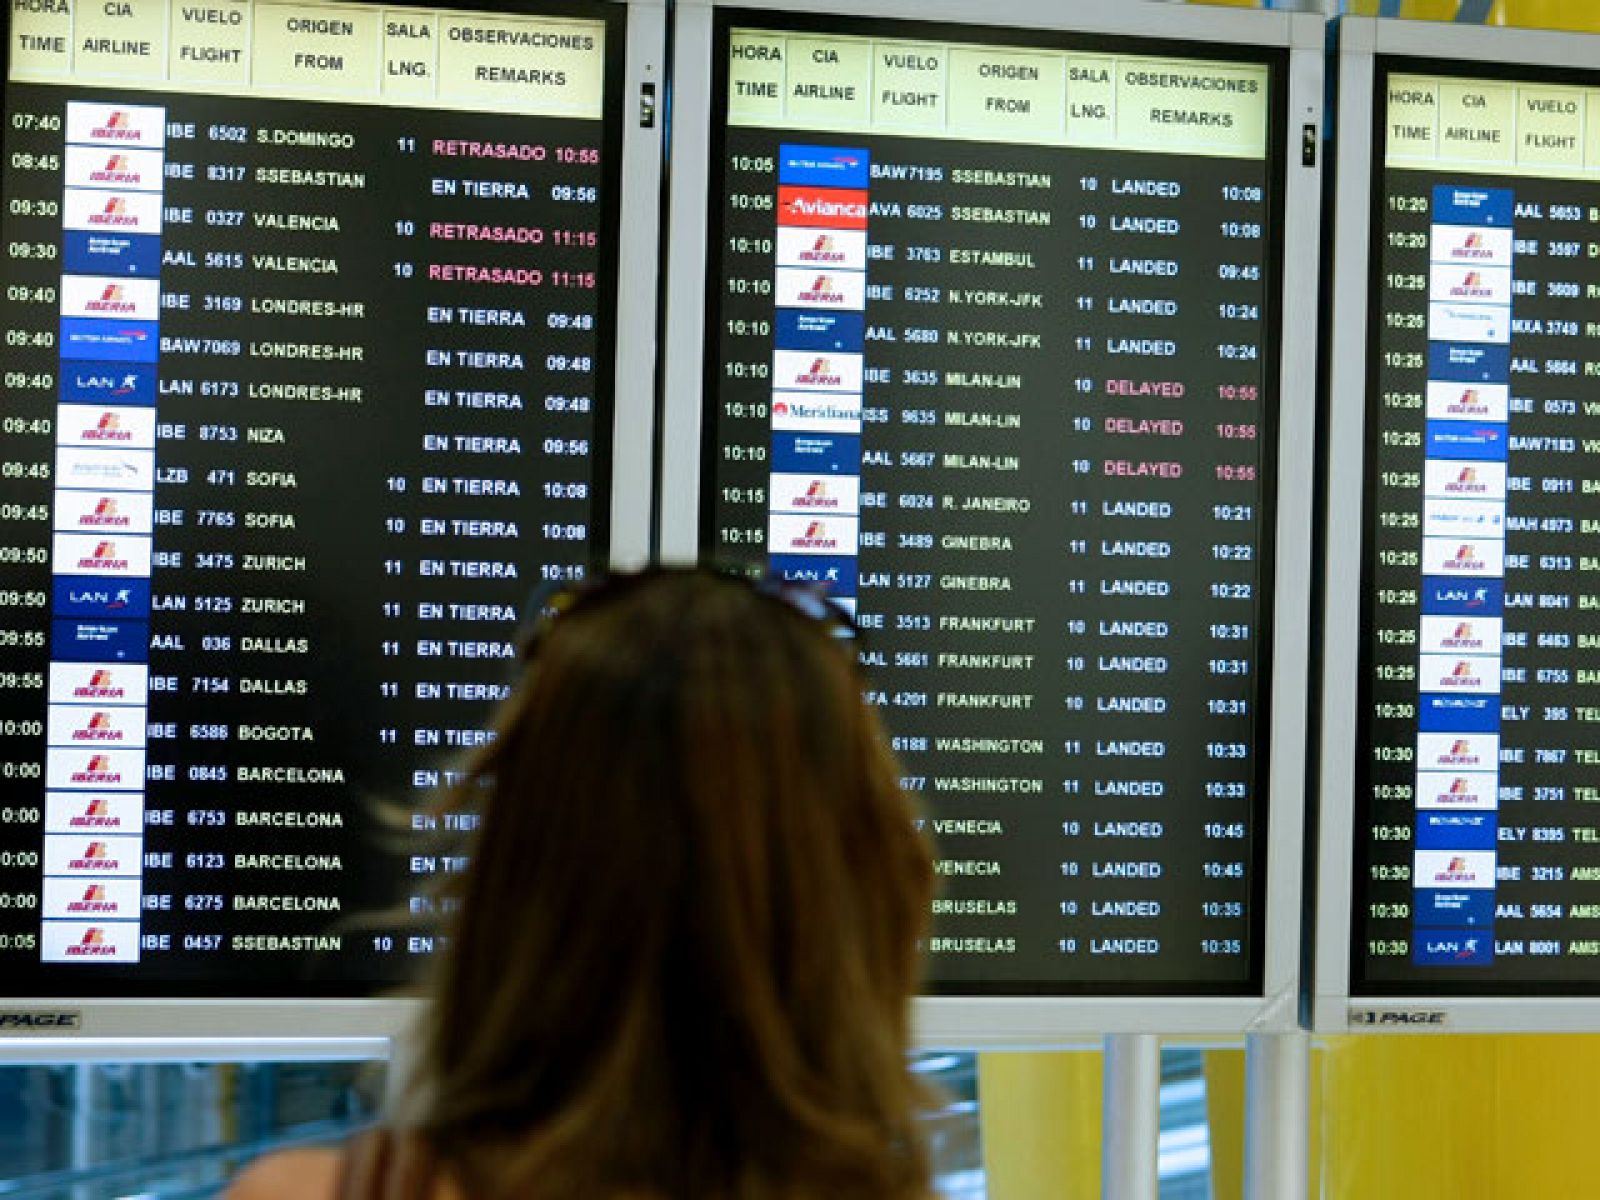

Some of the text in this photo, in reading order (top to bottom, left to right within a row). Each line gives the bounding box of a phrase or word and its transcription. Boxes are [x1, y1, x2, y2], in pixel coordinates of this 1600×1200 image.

[14, 0, 594, 51] HORA CIA VUELO ORIGEN SALA OBSERVACIONES
[19, 34, 566, 86] TIME AIRLINE FLIGHT FROM LNG. REMARKS
[732, 45, 1258, 94] HORA CIA VUELO ORIGEN SALA OBSERVACIONES
[735, 82, 1233, 127] TIME AIRLINE FLIGHT FROM LNG. REMARKS
[1389, 91, 1577, 114] HORA CIA VUELO
[12, 114, 599, 164] 07:40 IBERIA IBE 6502 S.DOMINGO 11 RETRASADO 10:55
[1393, 125, 1576, 149] TIME AIRLINE FLIGHT
[11, 153, 597, 202] 08:45 IBE 8317 SSEBASTIAN EN TIERRA 09:56
[731, 156, 774, 172] 10:05
[951, 170, 1051, 189] SSEBASTIAN
[1079, 177, 1098, 192] 10
[1111, 180, 1181, 197] LANDED
[730, 195, 773, 210] 10:05
[793, 198, 866, 218] Avianca
[869, 205, 901, 218] AVA
[951, 206, 1051, 225] SSEBASTIAN
[1078, 213, 1096, 229] 10
[1110, 219, 1180, 235] LANDED
[1389, 195, 1543, 219] 10:20 AAL
[10, 200, 58, 216] 09:30
[164, 206, 193, 223] IBE
[206, 210, 244, 226] 0327
[253, 213, 340, 232] VALENCIA
[395, 221, 414, 236] 10
[430, 222, 544, 243] RETRASADO
[552, 230, 597, 247] 11:15
[9, 243, 595, 288] 09:30 AAL 5615 VALENCIA 10 RETRASADO 11:15
[729, 238, 1178, 276] 10:10 ESTAMBUL LANDED
[7, 287, 592, 329] 09:40 IBERIA IBE 3169 LONDRES-HR EN TIERRA 09:48
[728, 278, 1258, 320] 10:10 N.YORK-JFK LANDED 10:24
[4, 373, 590, 412] 09:40 LAN LAN 6173 LONDRES-HR EN TIERRA 09:48
[945, 372, 1257, 400] MILAN-LIN DELAYED 10:55
[790, 402, 1183, 436] Meridiana DELAYED
[248, 428, 588, 456] NIZA 09:56
[2, 462, 586, 499] 09:45 LZB 471 SOFIA 10 EN TIERRA 10:08
[962, 498, 1031, 514] JANEIRO
[1103, 503, 1171, 519] LANDED
[1214, 505, 1252, 521] 10:21
[942, 536, 1251, 561] GINEBRA 10:22
[196, 553, 402, 574] 3475 ZURICH 11
[70, 592, 232, 613] LAN LAN 5125
[1379, 590, 1533, 608] 10:25 LAN LAN
[939, 616, 1249, 640] FRANKFURT 10:31
[202, 636, 308, 654] 036 DALLAS
[238, 725, 313, 741] BOGOTA
[936, 737, 1246, 758] WASHINGTON 10:33
[236, 767, 344, 784] BARCELONA
[933, 820, 1243, 838] VENECIA LANDED 10:45
[186, 853, 343, 871] 6123 BARCELONA
[931, 899, 1242, 917] BRUSELAS 10:35
[142, 935, 341, 951] IBE 0457 SSEBASTIAN
[1369, 940, 1523, 956] 10:30 LAN LAN
